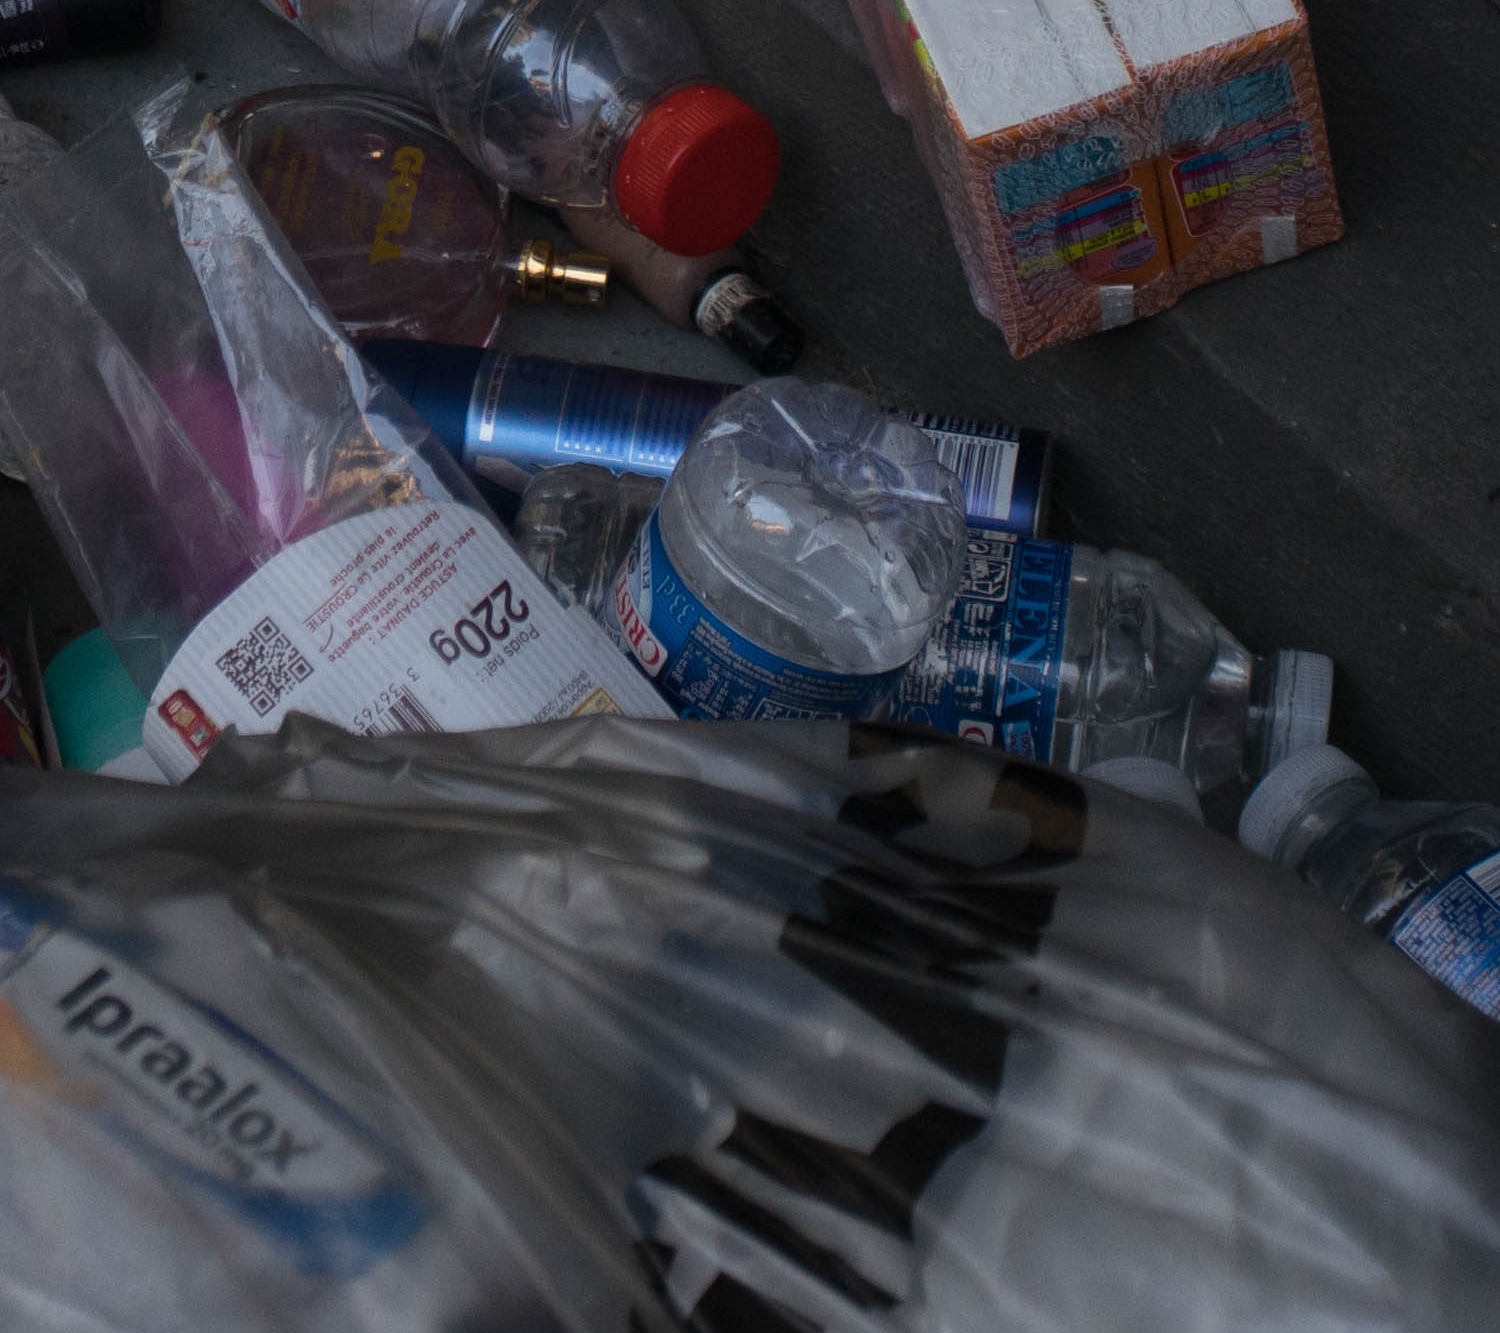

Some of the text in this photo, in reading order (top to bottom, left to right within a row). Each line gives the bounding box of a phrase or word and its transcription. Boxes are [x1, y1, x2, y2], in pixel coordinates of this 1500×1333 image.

[362, 535, 387, 561] plus
[392, 509, 441, 554] Retrouvez
[328, 553, 363, 588] proche
[418, 561, 459, 603] ASTUCE
[305, 583, 359, 633] CROUSTIE
[344, 573, 403, 628] croustillante
[428, 578, 533, 666] 220g
[327, 619, 376, 663] baguette
[504, 622, 541, 659] Poids
[406, 666, 420, 681] 3
[55, 966, 317, 1175] Ipraalox
